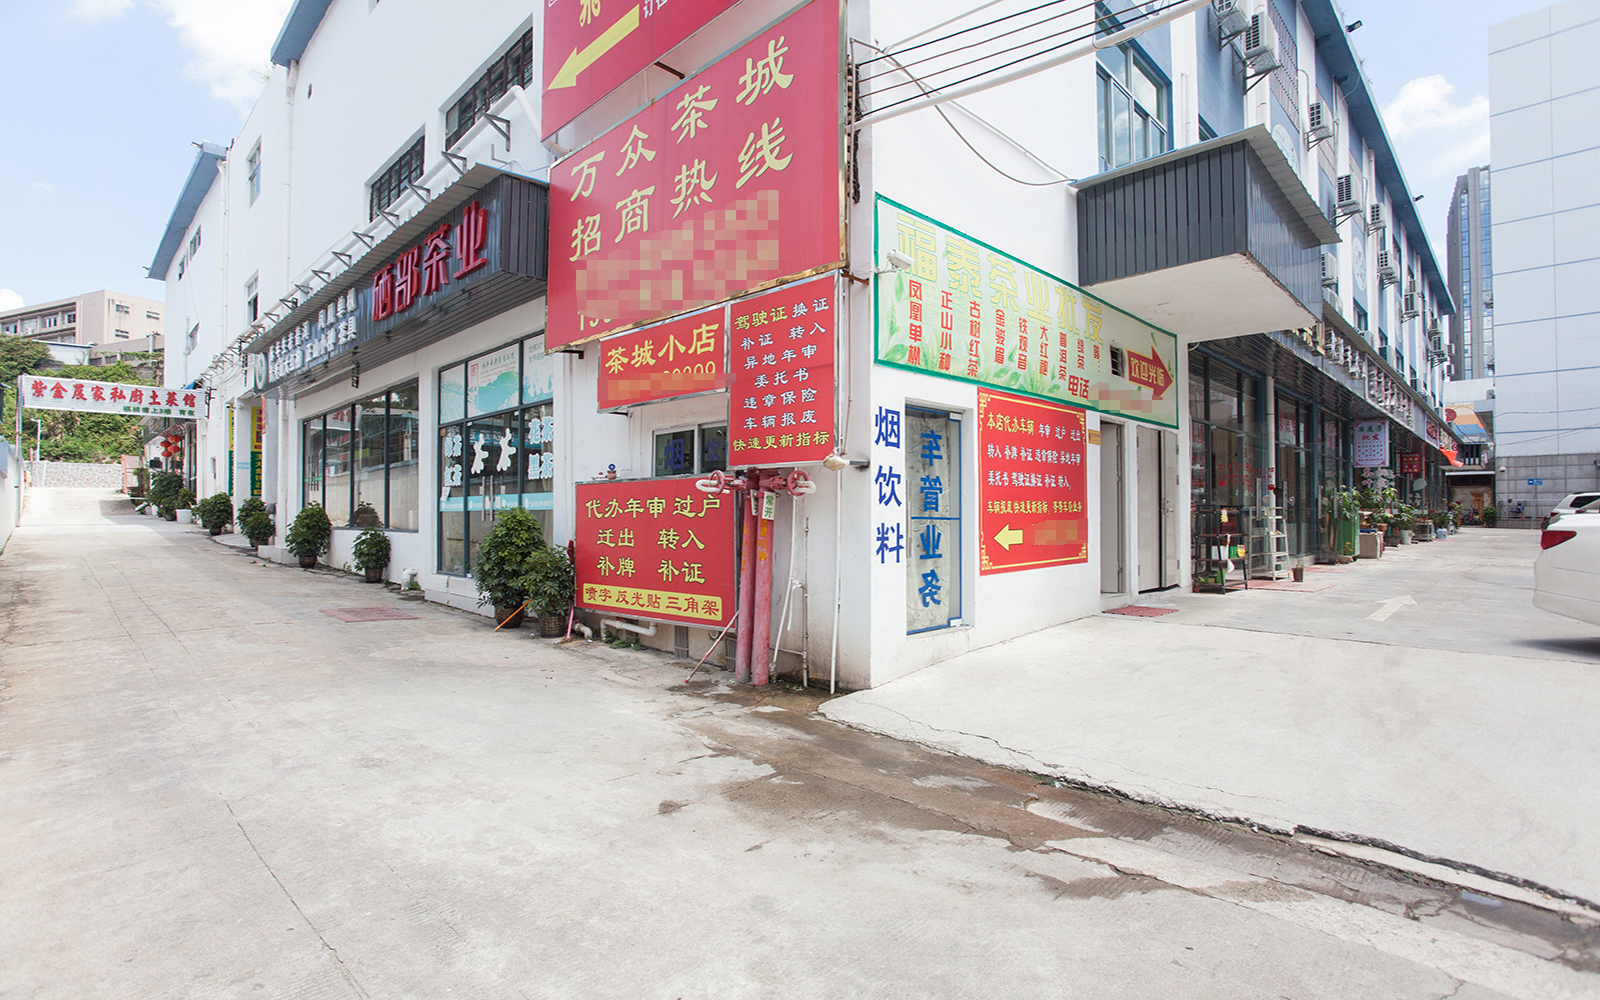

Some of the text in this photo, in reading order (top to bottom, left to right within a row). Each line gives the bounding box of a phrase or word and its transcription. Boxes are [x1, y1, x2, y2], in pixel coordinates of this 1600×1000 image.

[570, 36, 795, 202] 万众茶城
[569, 117, 794, 262] 招商热线
[897, 212, 1103, 344] 福泰茶业批发
[741, 321, 826, 351] 补证 转入
[938, 290, 953, 371] 正山小种
[967, 300, 981, 378] 古树红茶
[994, 309, 1006, 365] 金骏眉
[1017, 317, 1028, 371] 铁观音
[604, 323, 720, 375] 茶城小店
[744, 344, 818, 370] 异地年审
[1039, 325, 1049, 376] 大红袍
[754, 367, 810, 389] 委托书
[1068, 374, 1090, 399] 电话
[1130, 357, 1165, 387] 欢迎光临
[743, 387, 818, 410] 违章保险
[528, 416, 553, 445] 花茶
[743, 409, 818, 430] 车辆报废
[987, 411, 1035, 436] 本店代办车辆
[1039, 423, 1051, 438] 年审
[664, 438, 684, 470] 烟
[732, 430, 830, 452] 快速更新指标
[987, 443, 1002, 458] 转入
[1004, 444, 1018, 460] 补牌
[1020, 446, 1033, 462] 补证
[1035, 448, 1058, 464] 违章保险
[528, 451, 553, 480] 黑茶
[988, 470, 1009, 486] 委托书
[1044, 473, 1057, 488] 补证
[585, 493, 721, 519] 代办年审 过户
[918, 430, 943, 608] 车管业务
[597, 527, 705, 550] 迁出 转入
[596, 556, 706, 584] 补牌 补证
[585, 586, 720, 617] 喷字 反光贴 三角架
